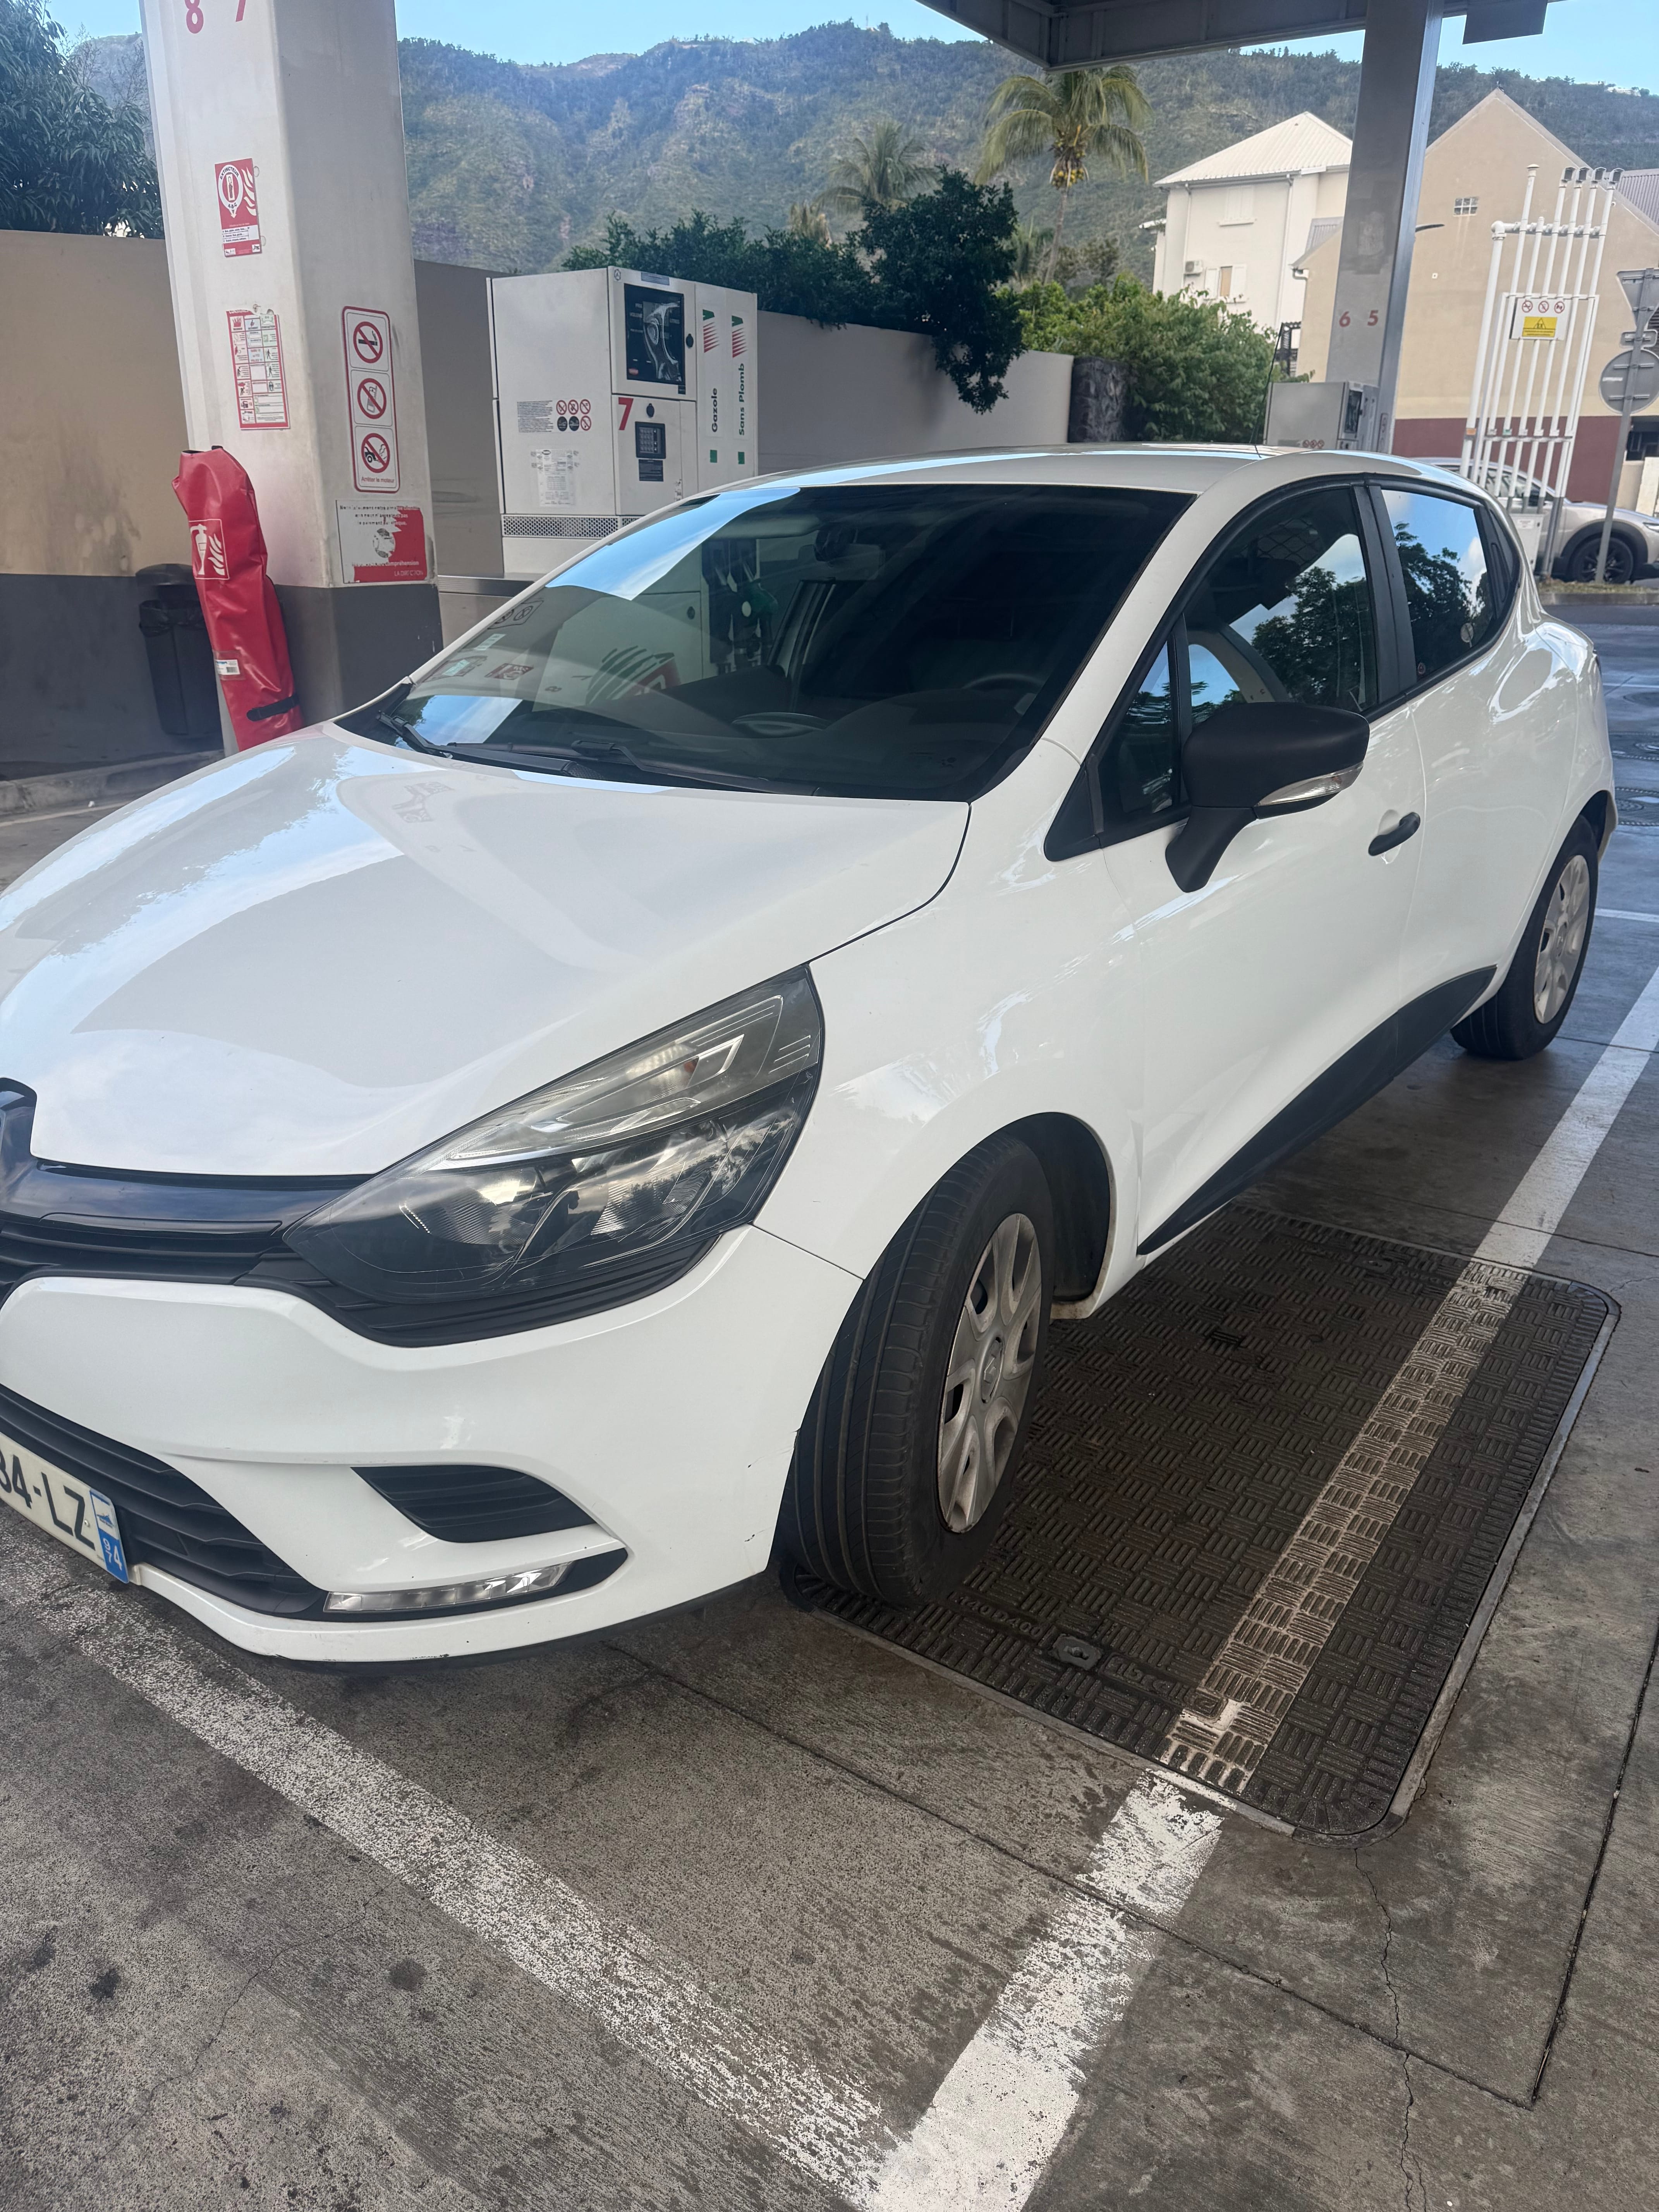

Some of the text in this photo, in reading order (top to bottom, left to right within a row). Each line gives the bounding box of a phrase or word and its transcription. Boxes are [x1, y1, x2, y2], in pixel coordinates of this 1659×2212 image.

[1339, 310, 1378, 327] 6 5
[618, 397, 634, 430] 7
